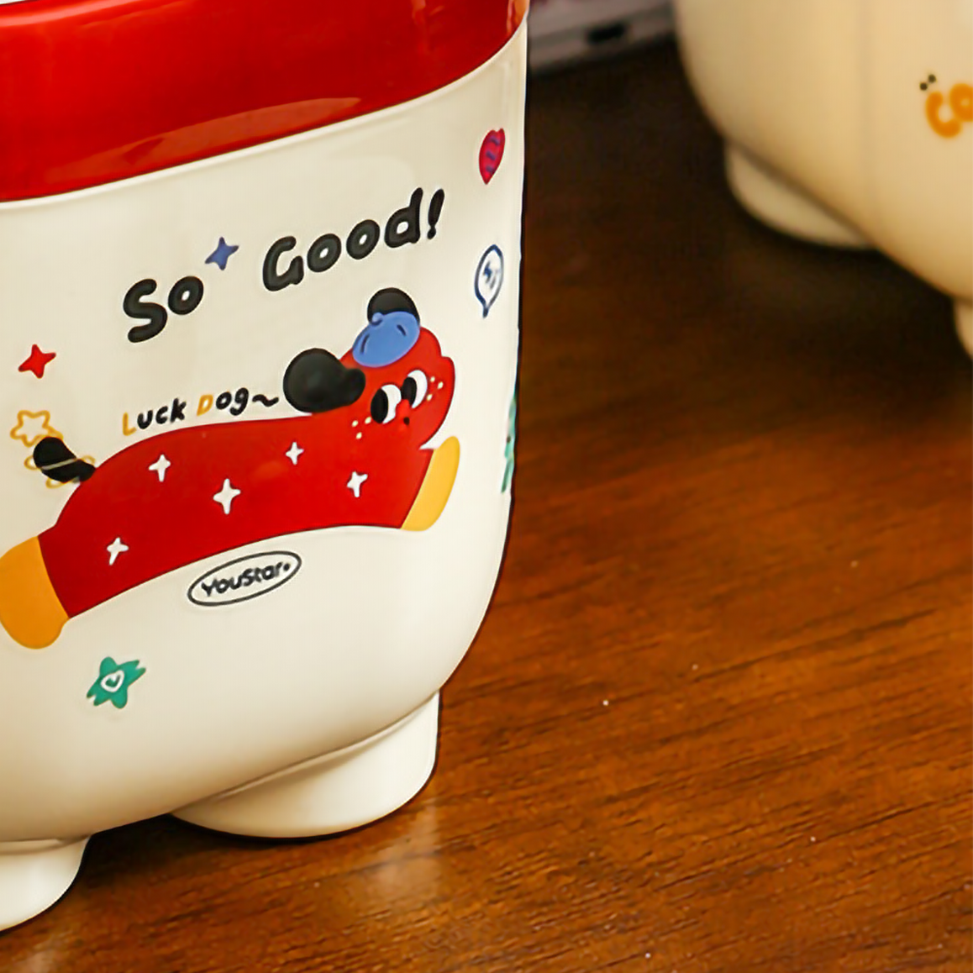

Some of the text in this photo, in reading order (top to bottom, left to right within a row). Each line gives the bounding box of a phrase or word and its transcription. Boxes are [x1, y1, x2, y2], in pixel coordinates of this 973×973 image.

[123, 276, 204, 343] So
[263, 187, 445, 291] Good!
[122, 397, 187, 436] Luck
